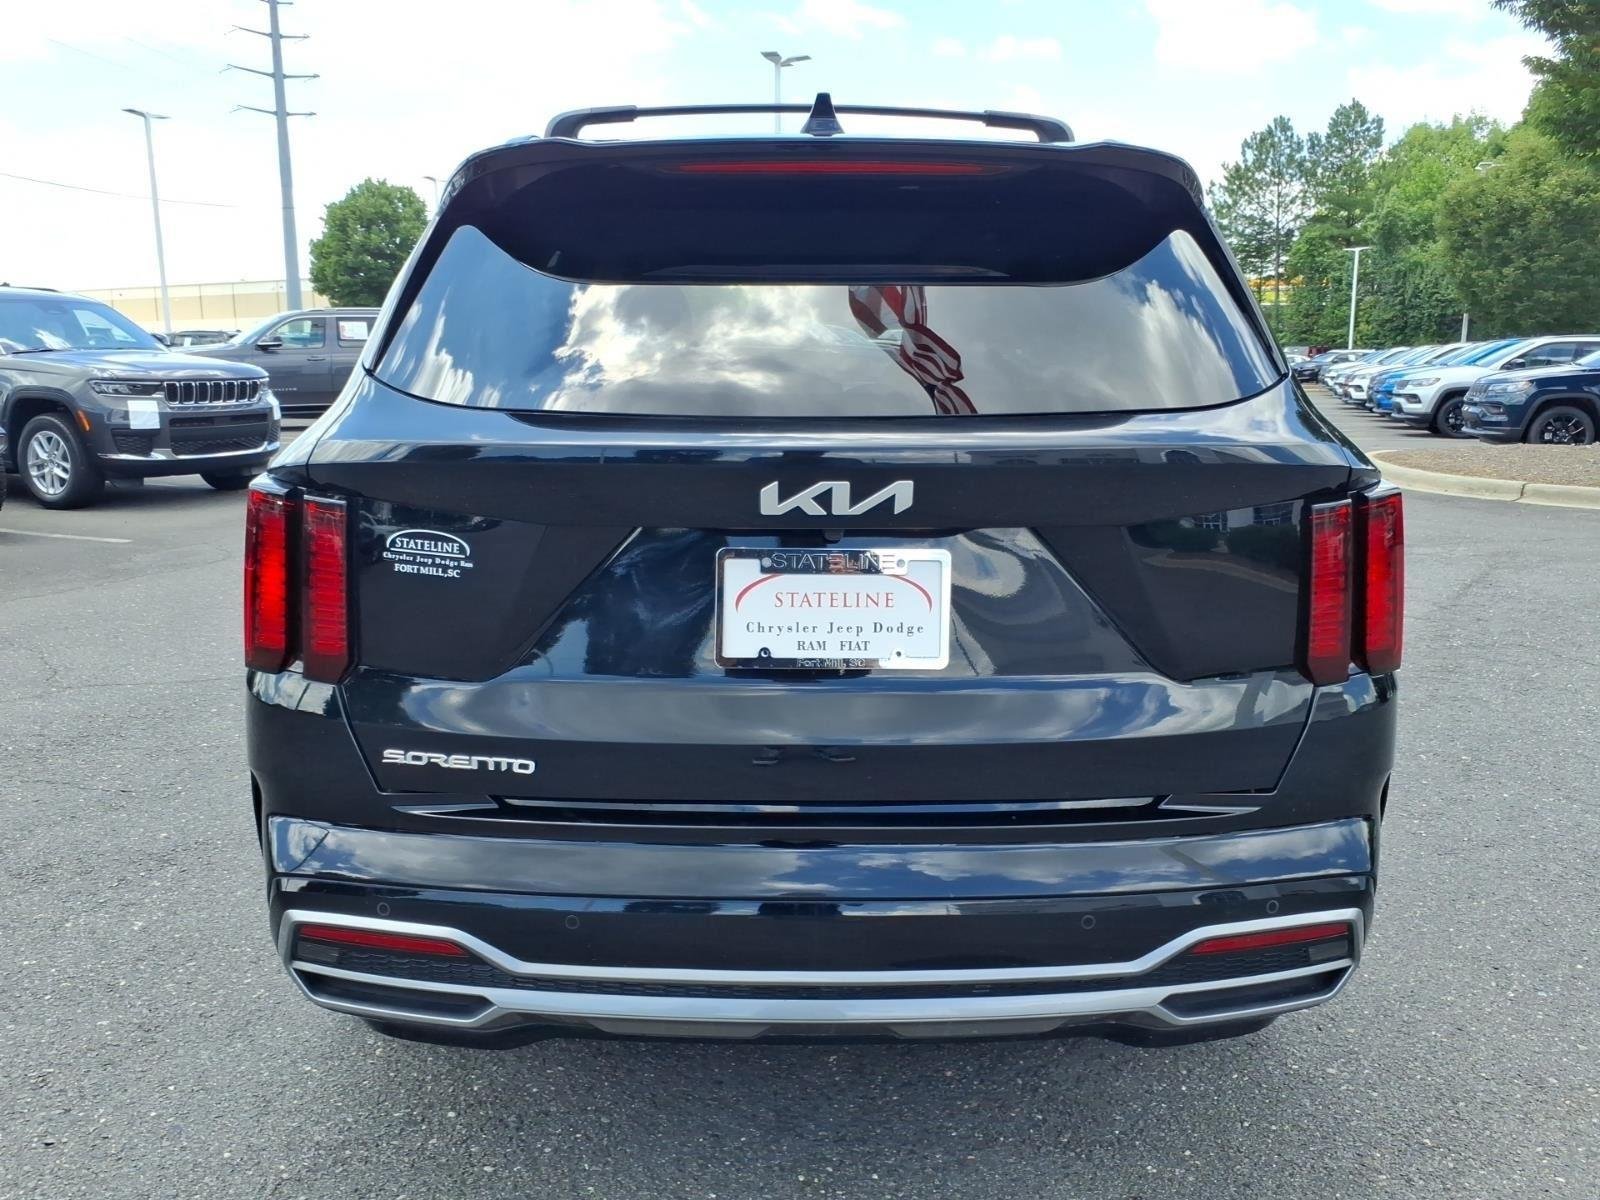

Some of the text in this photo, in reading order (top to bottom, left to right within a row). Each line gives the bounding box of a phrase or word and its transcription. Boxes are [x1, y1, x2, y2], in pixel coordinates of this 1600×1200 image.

[760, 480, 914, 516] KIA
[395, 537, 460, 554] STATELINE
[382, 551, 414, 562] Chrysler
[415, 555, 433, 565] Jeep
[434, 557, 459, 568] Dodge
[771, 552, 896, 570] STATELINE
[394, 563, 419, 574] FORT
[774, 592, 895, 609] STATELINE
[745, 621, 925, 637] Chrysler Jeep Dodge
[797, 640, 871, 652] RAM FIAT
[796, 658, 821, 669] Fort
[848, 658, 866, 668] SC
[382, 749, 536, 775] SORENTO
